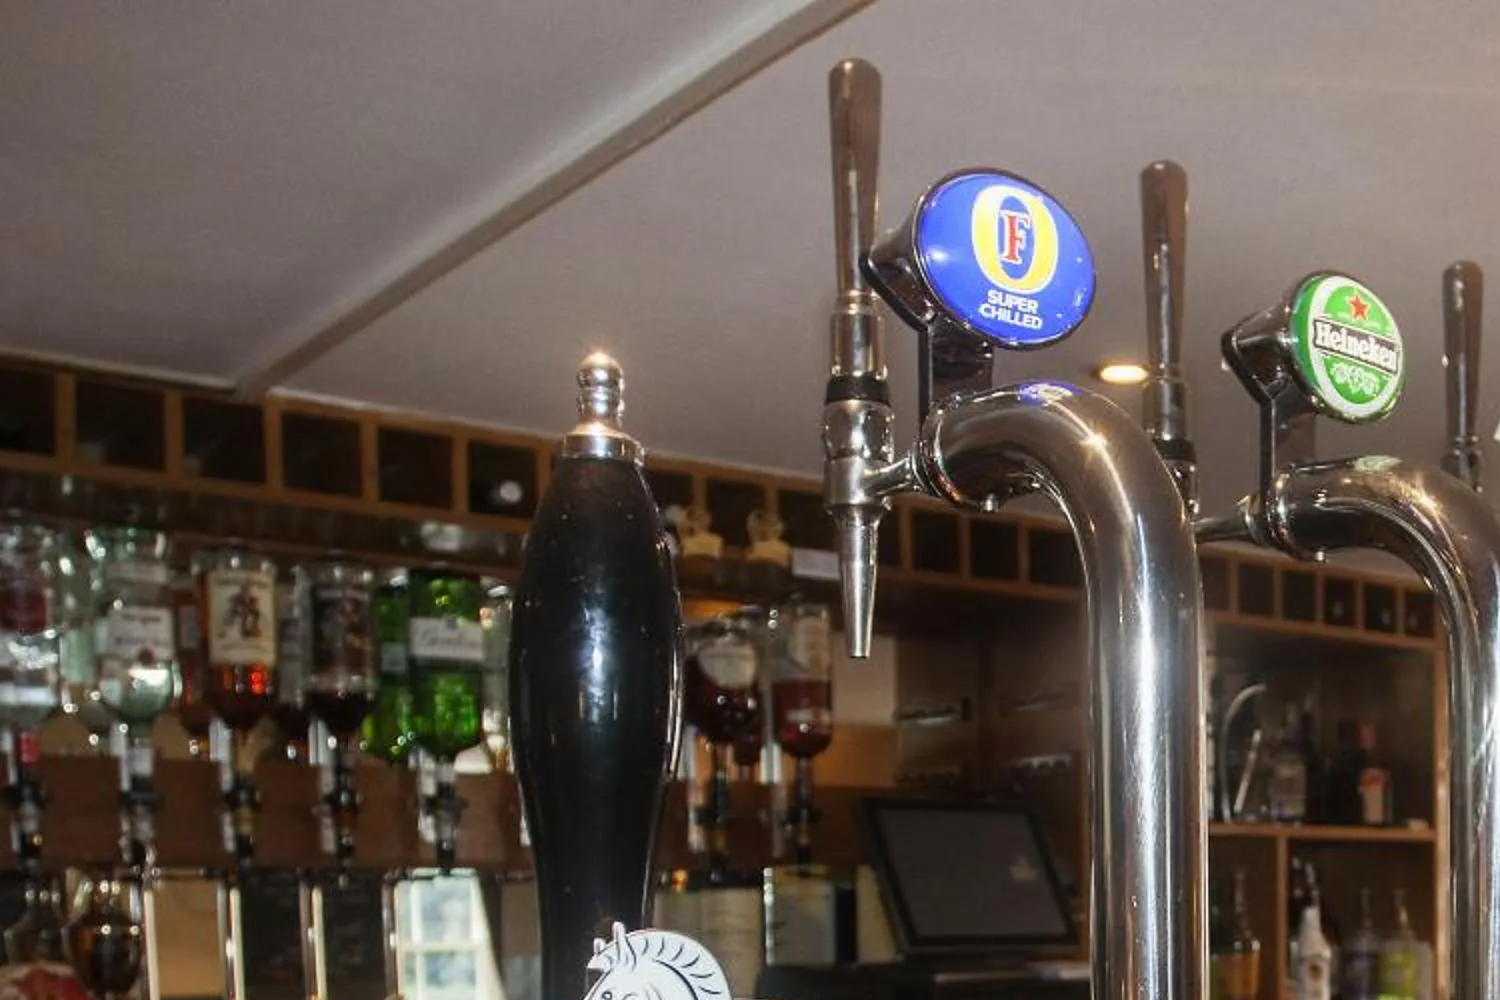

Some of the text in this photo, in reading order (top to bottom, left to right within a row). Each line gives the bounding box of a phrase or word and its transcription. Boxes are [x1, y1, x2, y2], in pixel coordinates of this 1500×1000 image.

[979, 302, 1043, 330] CHILLED
[986, 289, 1039, 315] SUPER
[1315, 320, 1398, 374] Heineken
